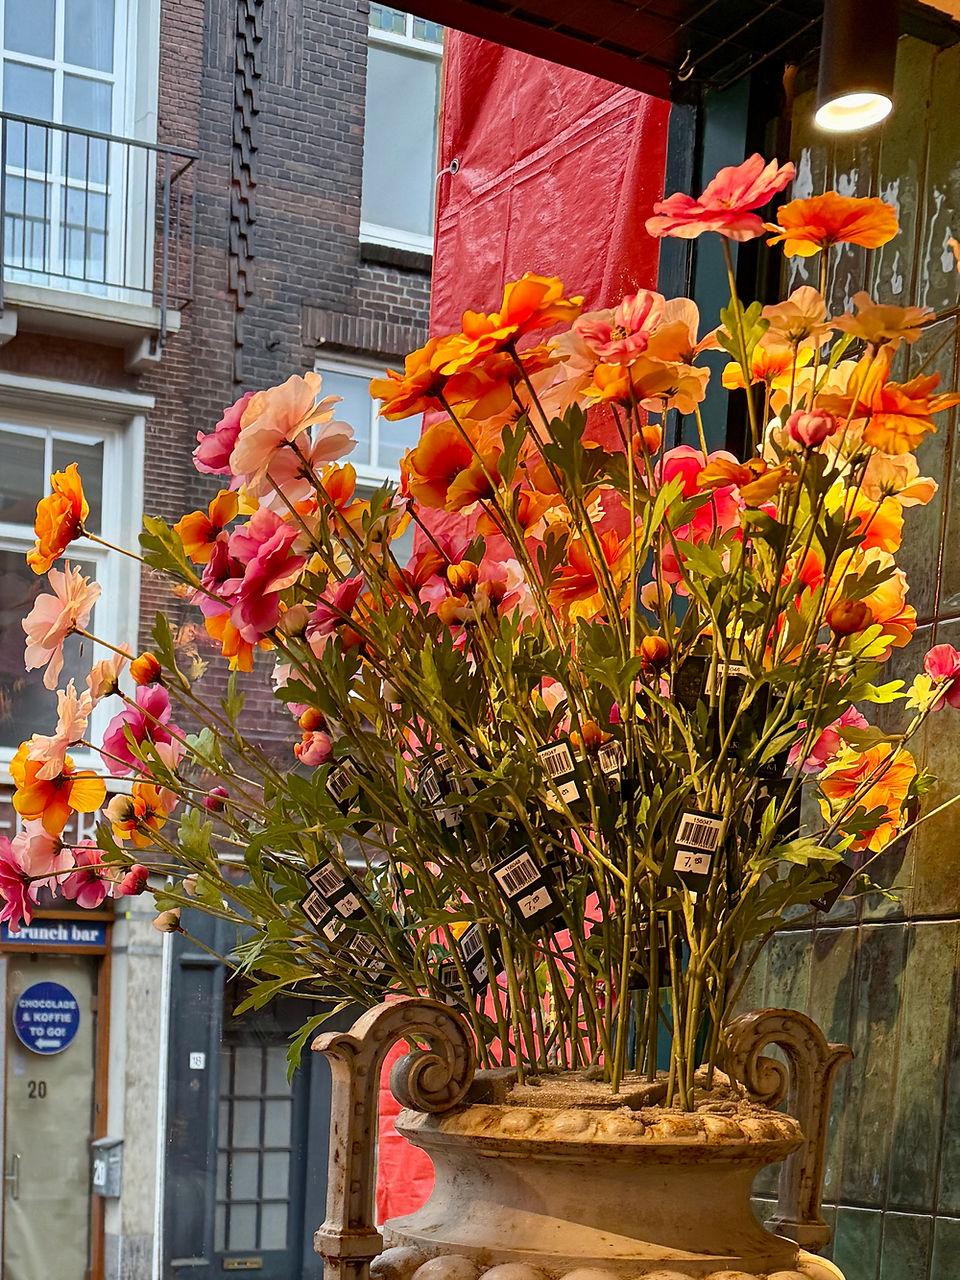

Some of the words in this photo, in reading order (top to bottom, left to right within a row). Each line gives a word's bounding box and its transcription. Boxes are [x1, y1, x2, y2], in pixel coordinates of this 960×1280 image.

[72, 924, 100, 942] bar
[22, 1012, 31, 1023] &
[32, 1012, 72, 1024] KOFFIE
[29, 1026, 45, 1037] TO
[46, 1027, 67, 1038] GO!
[27, 1080, 48, 1100] 20
